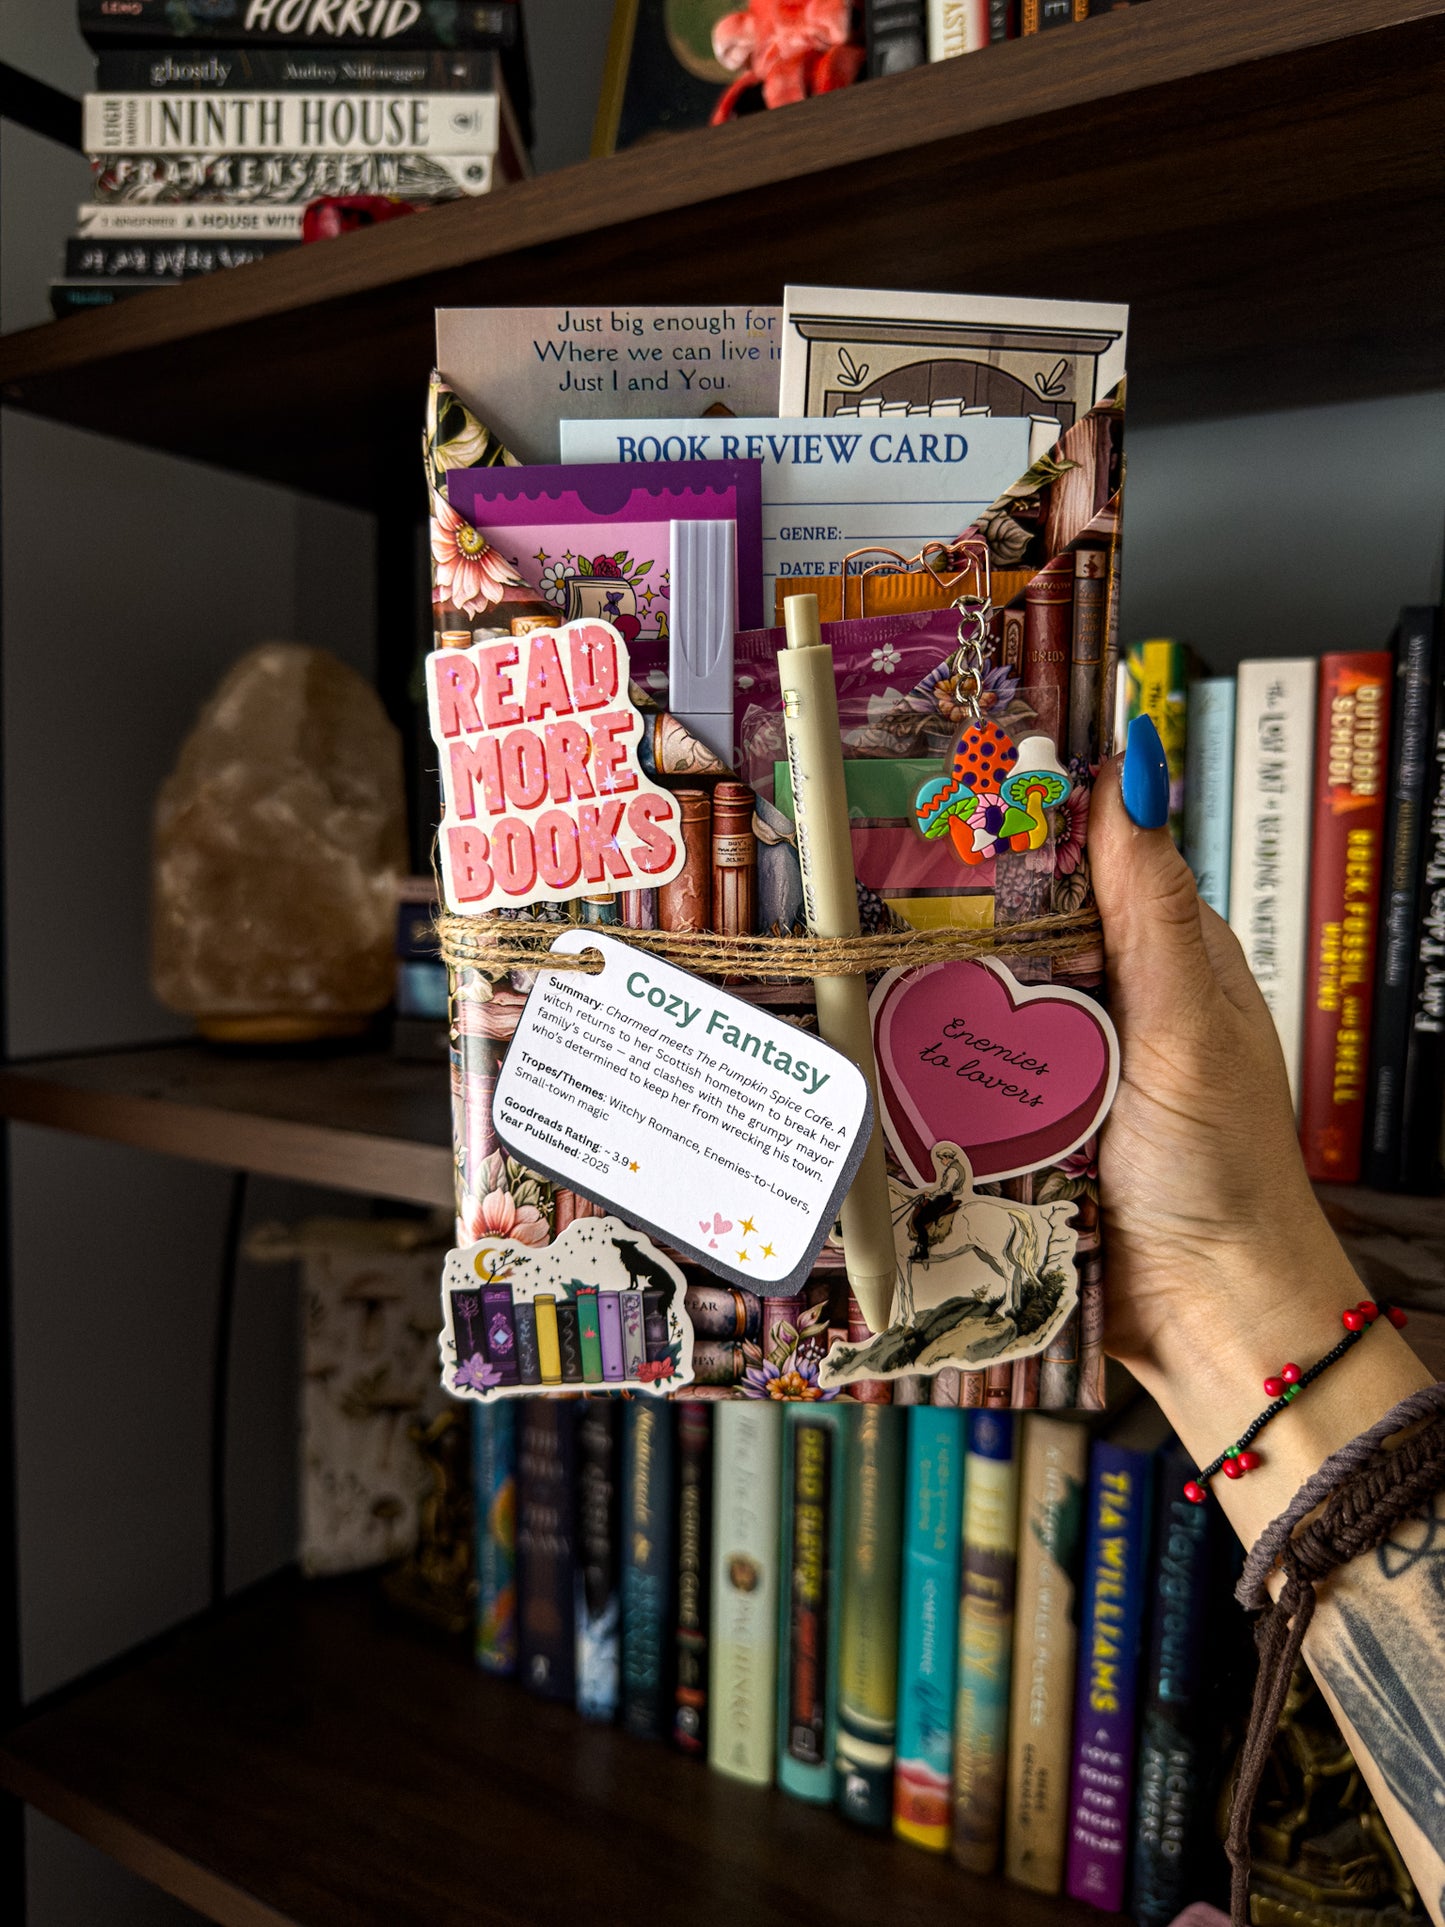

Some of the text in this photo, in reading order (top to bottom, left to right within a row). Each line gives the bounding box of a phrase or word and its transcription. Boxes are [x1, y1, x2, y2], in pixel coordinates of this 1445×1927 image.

[244, 0, 421, 38] HORRID
[151, 56, 231, 86] ghostly
[160, 98, 430, 147] NINTH HOUSE
[115, 157, 400, 188] FRANKENSTEIN
[202, 212, 260, 229] HOUSE
[533, 340, 619, 363] Where
[628, 347, 663, 361] we
[672, 344, 711, 361] can
[722, 340, 760, 361] live
[557, 309, 776, 336] Just big enough for
[559, 369, 731, 392] Just I and You.
[617, 434, 969, 464] BOOK REVIEW CARD
[779, 527, 842, 541] GENRE:
[780, 562, 824, 576] DATE
[435, 625, 619, 738] READ
[449, 709, 639, 820] MORE
[788, 734, 808, 813] chapter
[1328, 695, 1355, 787] SCHOOL
[1351, 684, 1383, 796] OUTDOOR
[447, 792, 677, 903] BOOKS
[799, 821, 810, 877] more
[1317, 922, 1342, 1012] HUNTING
[549, 976, 847, 1137] Summary: Charmed meets The Pumpkin Spice Cafe. A
[626, 972, 831, 1095] Cozy Fantasy
[942, 1016, 1050, 1077] Enemies
[1333, 1029, 1363, 1105] SHELL
[515, 1066, 610, 1122] Small-town magic
[532, 1023, 824, 1183] who’s determined to keep her from wrecking his town.
[537, 1006, 580, 1035] family’s
[582, 1030, 614, 1052] curse
[628, 1053, 651, 1071] and
[653, 1066, 695, 1095] clashes
[698, 1090, 723, 1109] with
[726, 1103, 746, 1121] the
[749, 1118, 794, 1147] grumpy
[795, 1142, 835, 1168] mayor
[543, 992, 841, 1154] witch returns to her Scottish hometown to break her
[919, 1042, 1044, 1108] to lovers
[499, 1110, 610, 1175] Year Published: 2025
[504, 1096, 563, 1132] Goodreads
[565, 1126, 603, 1154] Rating:
[611, 1151, 629, 1168] 3.9
[521, 1051, 811, 1214] Tropes/Themes: Witchy Romance, Enemies-to-Lovers,
[796, 1428, 824, 1496] DEAD
[963, 1571, 1001, 1681] FURY
[1090, 1470, 1131, 1714] TIA WILLIAMS
[1158, 1501, 1206, 1701] Playground
[1138, 1747, 1166, 1846] POWERS
[1160, 1750, 1191, 1858] RICHARD
